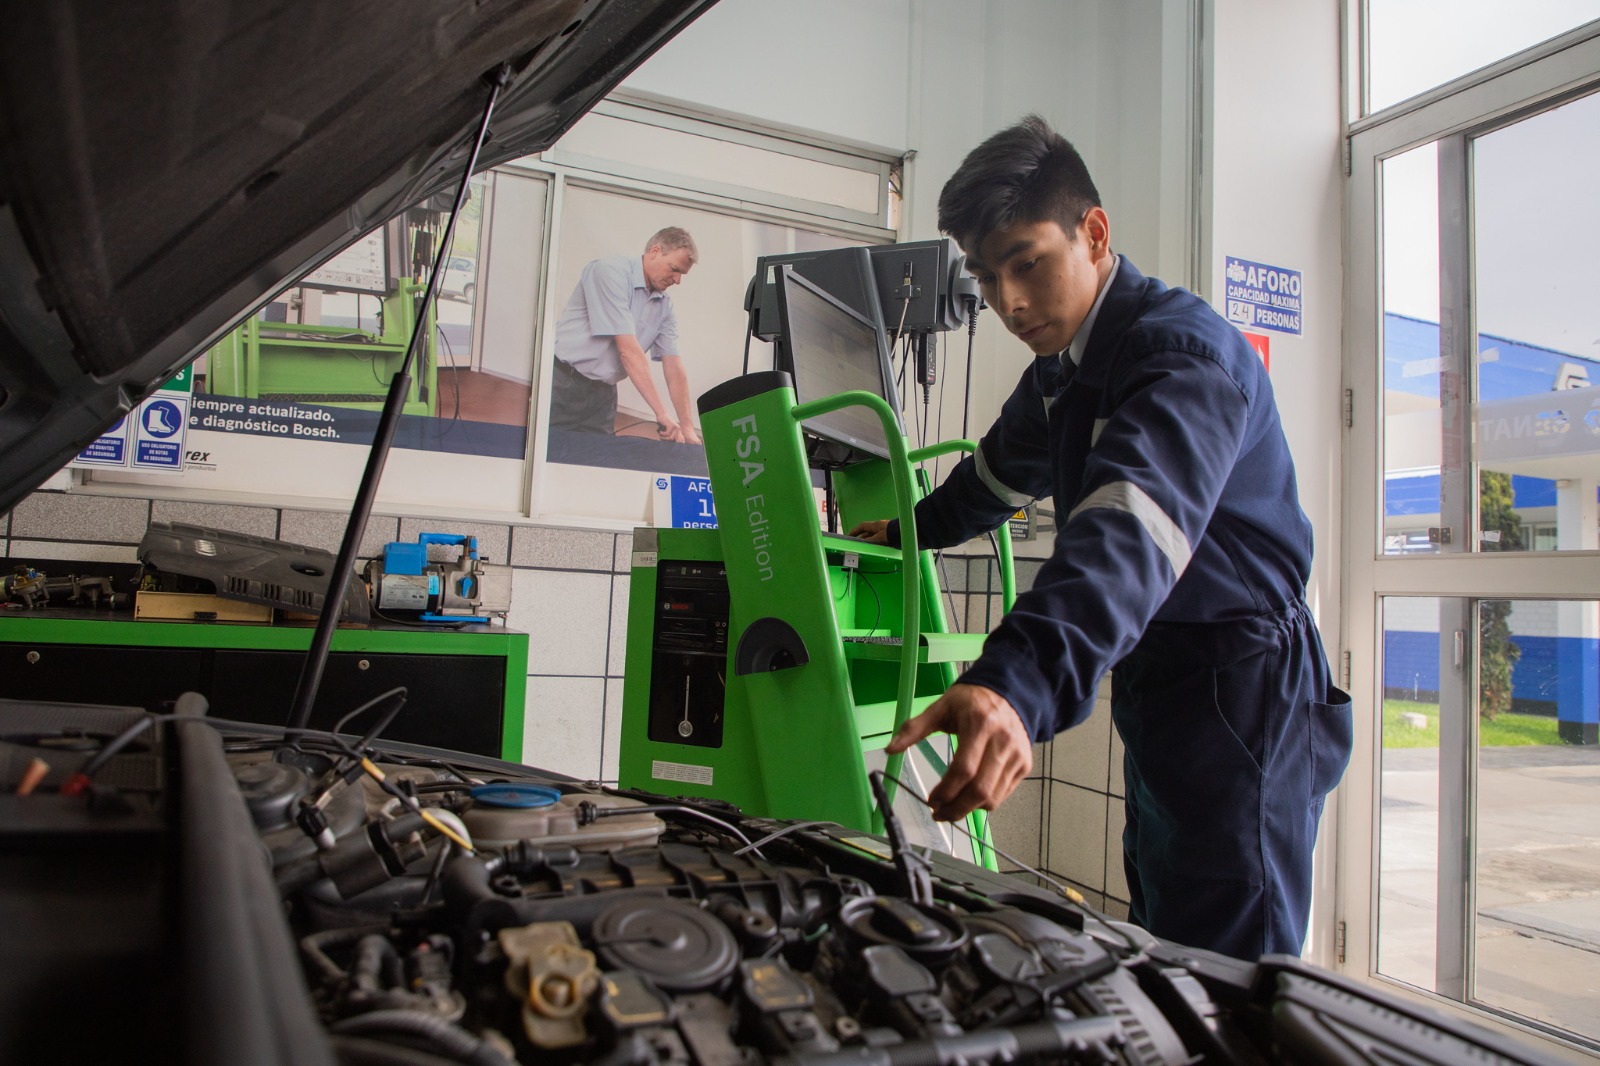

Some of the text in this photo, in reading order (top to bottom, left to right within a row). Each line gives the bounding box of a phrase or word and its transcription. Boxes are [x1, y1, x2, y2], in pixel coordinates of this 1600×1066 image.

[1246, 266, 1300, 296] AFORO
[1228, 285, 1301, 310] CAPACIDAD MAXIMA
[1232, 302, 1300, 331] 24 PERSONAS
[191, 396, 335, 422] iempre actualizado.
[202, 415, 288, 433] diagnóstico
[293, 423, 341, 439] Bosch.
[731, 413, 774, 582] FSA Edition
